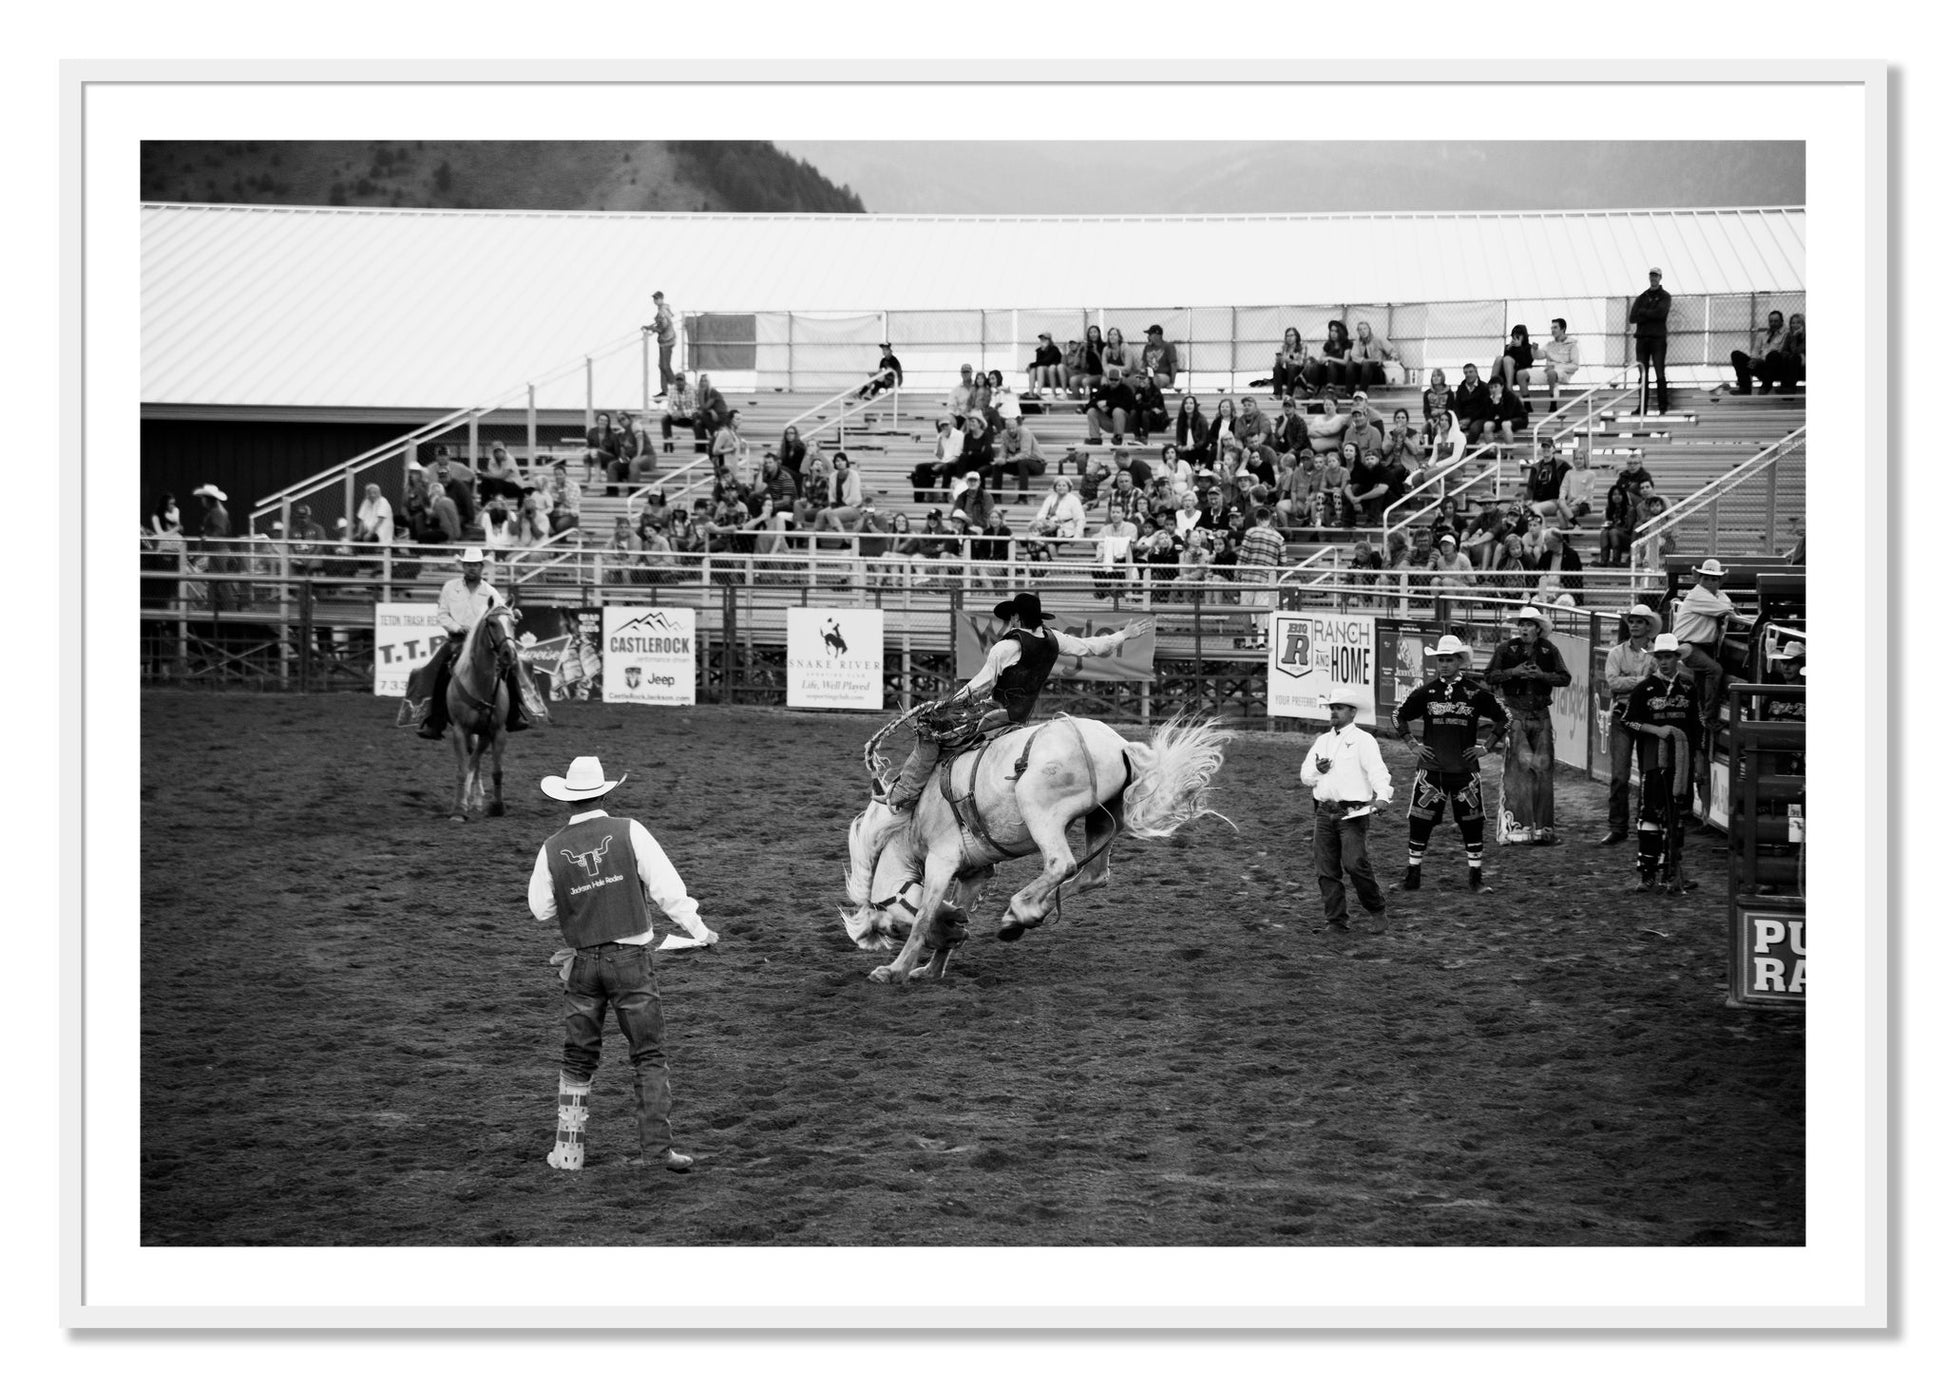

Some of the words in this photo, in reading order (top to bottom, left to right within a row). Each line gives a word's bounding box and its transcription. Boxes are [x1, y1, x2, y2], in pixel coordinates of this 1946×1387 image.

[380, 615, 401, 626] TETON
[403, 615, 425, 627] TRASH
[1287, 623, 1308, 634] BIG
[1314, 620, 1370, 645] RANCH
[610, 636, 690, 654] CASTLEROCK
[1281, 634, 1310, 665] R
[788, 659, 832, 669] SNAKE
[839, 660, 881, 671] RIVER
[1331, 645, 1370, 685] HOME
[647, 672, 676, 688] Jeep
[822, 680, 842, 690] Well
[842, 681, 872, 693] Played
[1275, 695, 1290, 706] YOUR
[570, 885, 592, 895] Jackson
[592, 879, 605, 888] Hole
[605, 874, 624, 883] Rodeo
